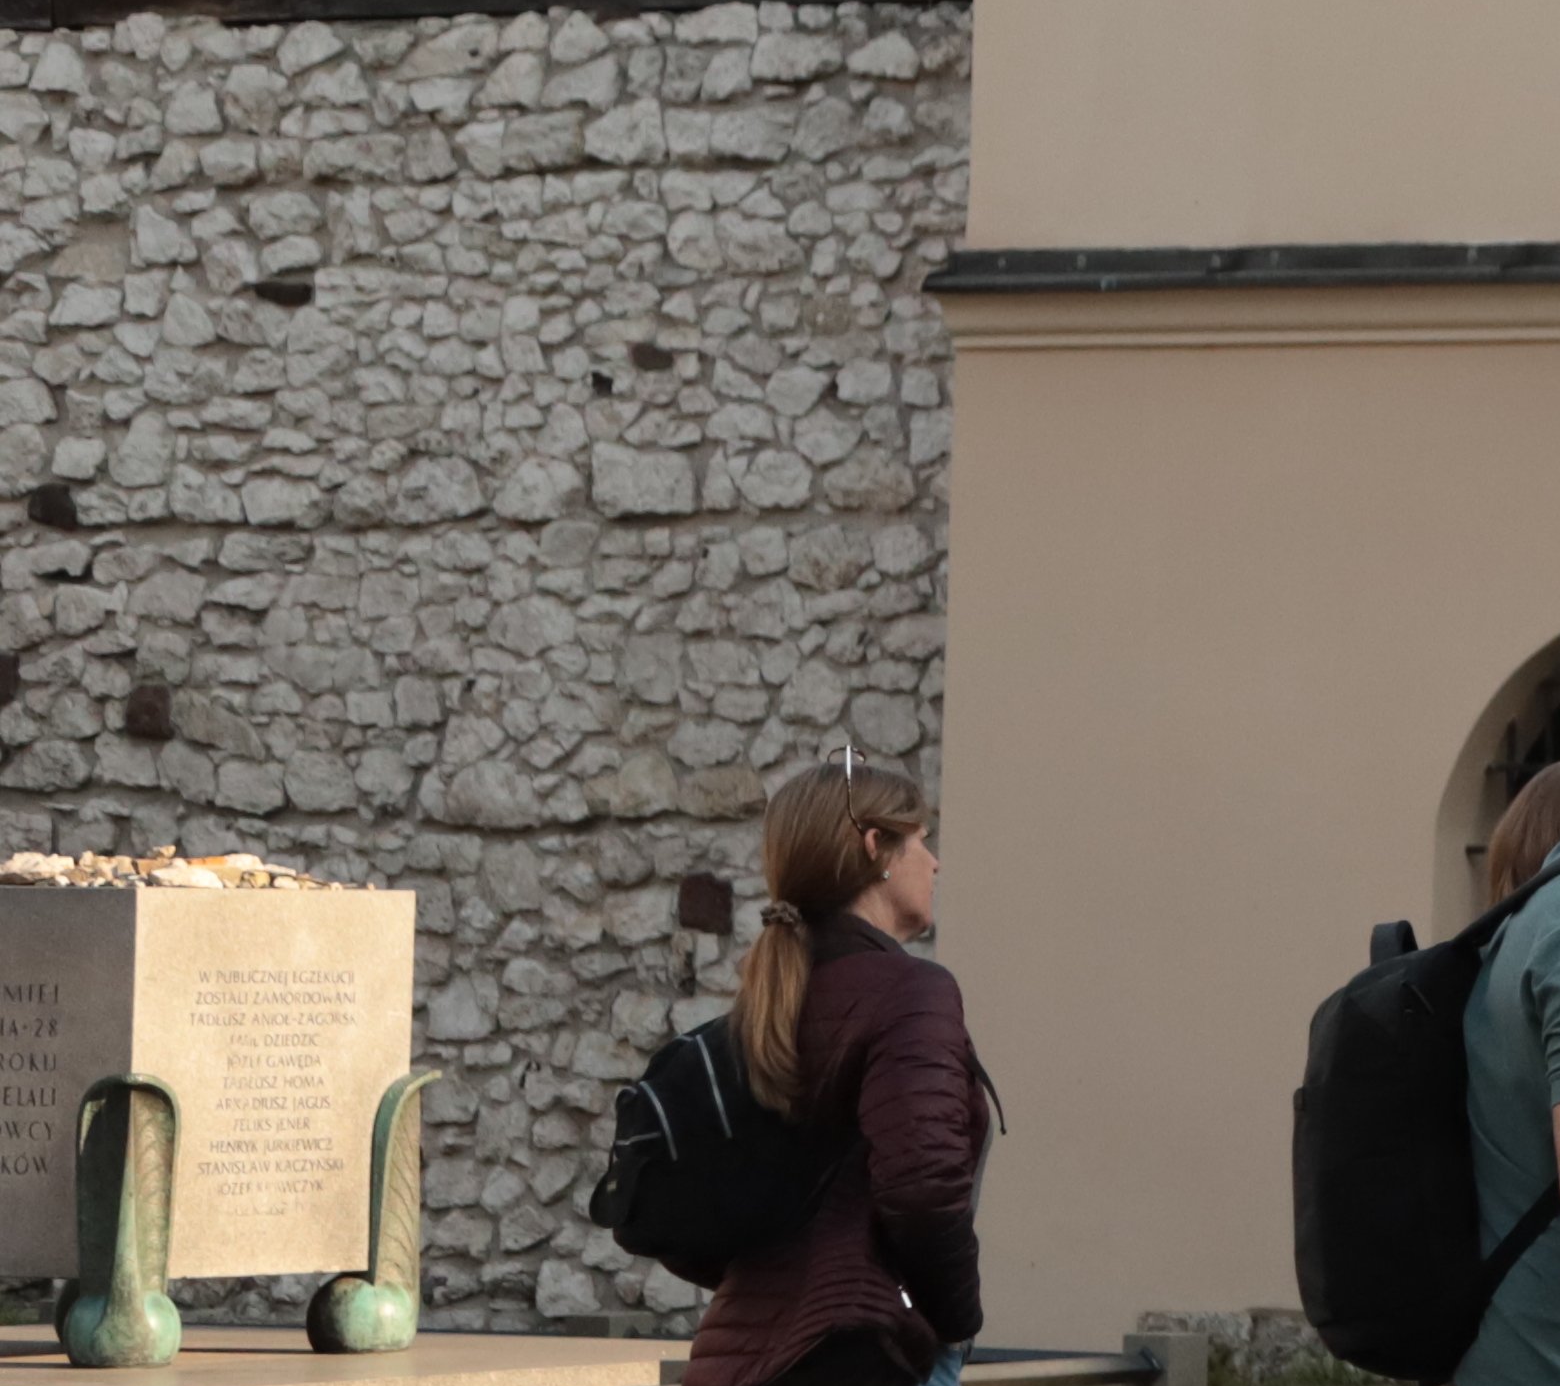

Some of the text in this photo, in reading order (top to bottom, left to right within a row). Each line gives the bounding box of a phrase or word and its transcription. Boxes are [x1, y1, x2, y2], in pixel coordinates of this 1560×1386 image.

[198, 969, 355, 986] W PUBLICZNEJ EGZEKUCJI
[195, 990, 357, 1006] ZOSTALI ZAMORDOWANI
[189, 1011, 247, 1027] TADEUSZ
[263, 1032, 322, 1047] DZIEDZIC
[265, 1053, 322, 1071] GAWĘDA
[222, 1075, 325, 1090] TADEUSZ HOMA
[215, 1094, 332, 1112] ARKADIUSZ JAGUS
[0, 1120, 54, 1142] WCY
[232, 1117, 273, 1132] FELIKS
[209, 1137, 334, 1155] HENRYK JURKIEWICZ
[196, 1160, 271, 1176] STANISŁAW
